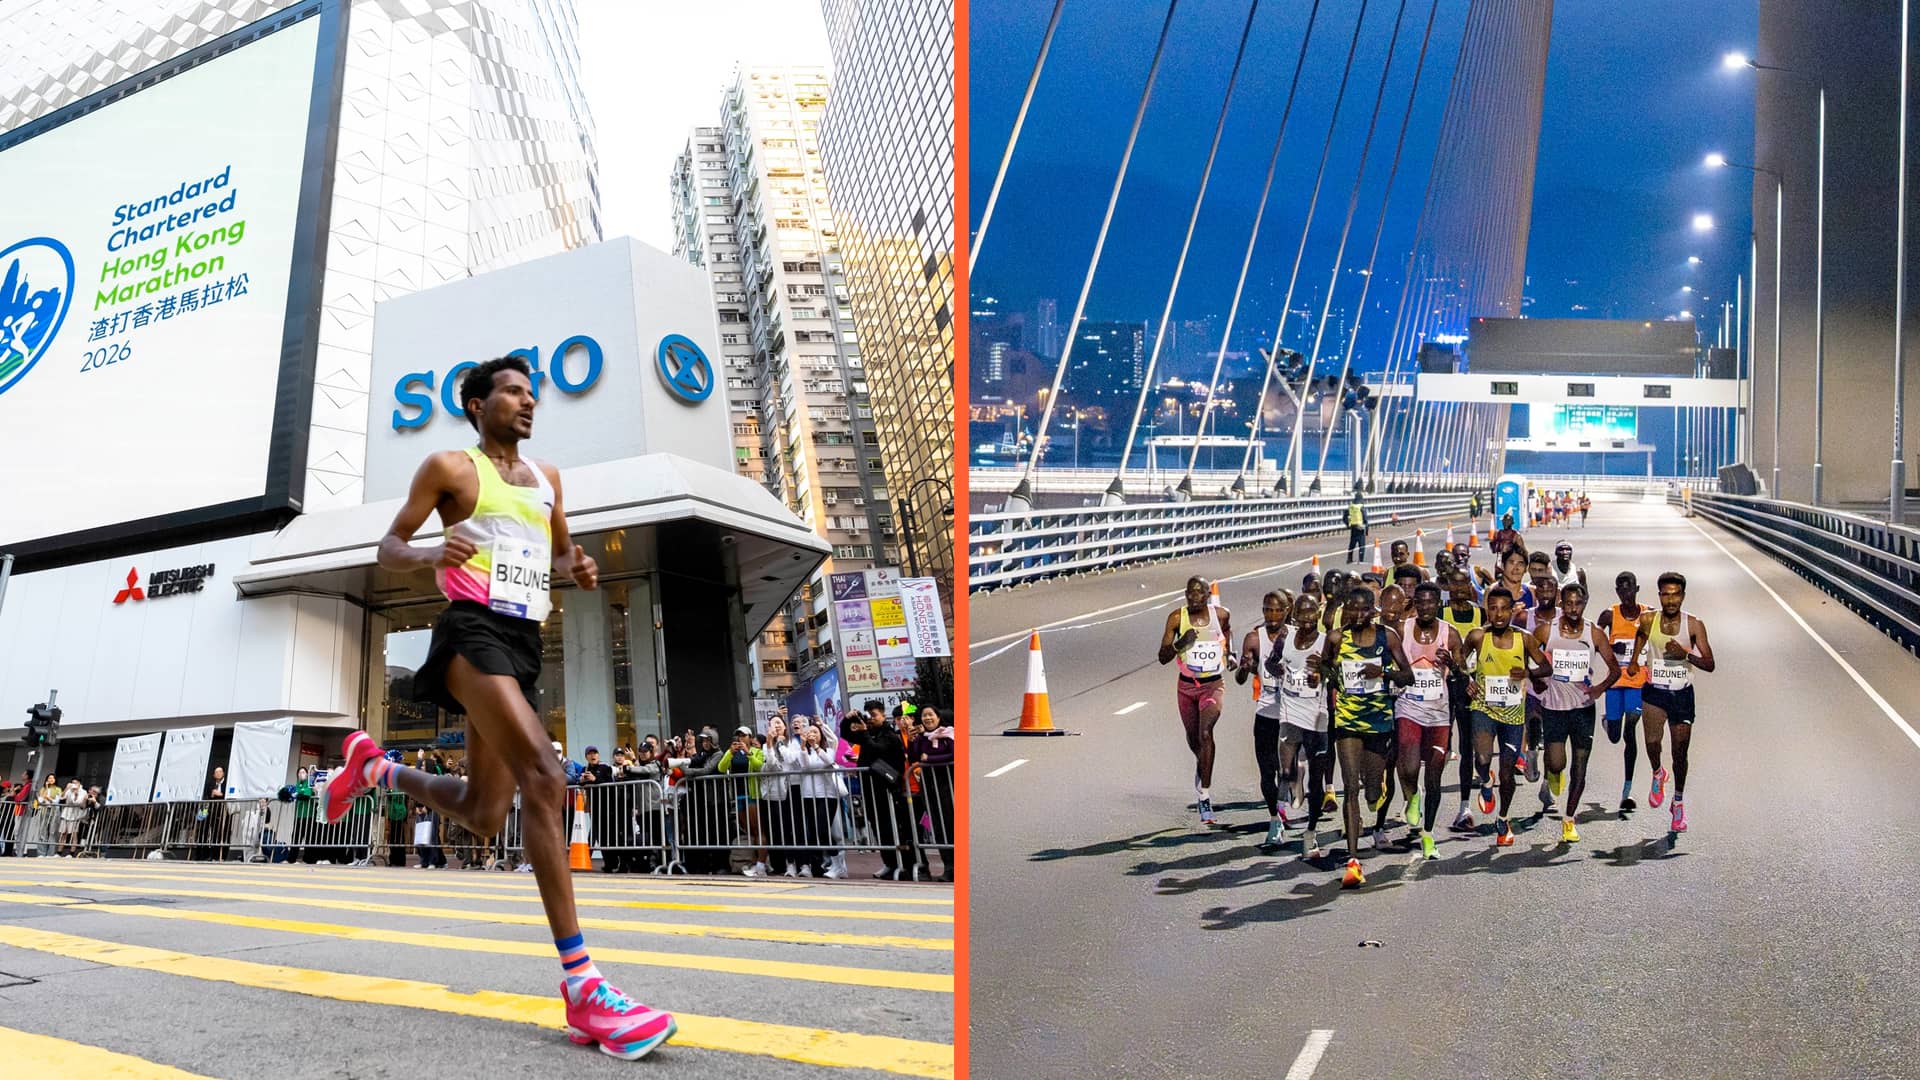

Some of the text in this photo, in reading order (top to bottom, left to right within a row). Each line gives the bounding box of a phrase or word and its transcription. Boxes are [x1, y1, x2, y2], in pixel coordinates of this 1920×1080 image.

[112, 164, 232, 227] Standard
[107, 189, 237, 252] Chartered
[100, 220, 246, 283] Hong Kong
[93, 255, 225, 312] Marathon
[87, 272, 250, 343] 渣打香港馬拉松
[80, 340, 132, 373] 2026
[149, 563, 215, 585] MITSUBISHI
[147, 578, 205, 599] ELECTRIC
[1192, 651, 1216, 660] TOO
[1554, 660, 1588, 669] ZERIHUN
[1413, 679, 1442, 688] EBRE
[1653, 669, 1687, 679] BIZUNEH
